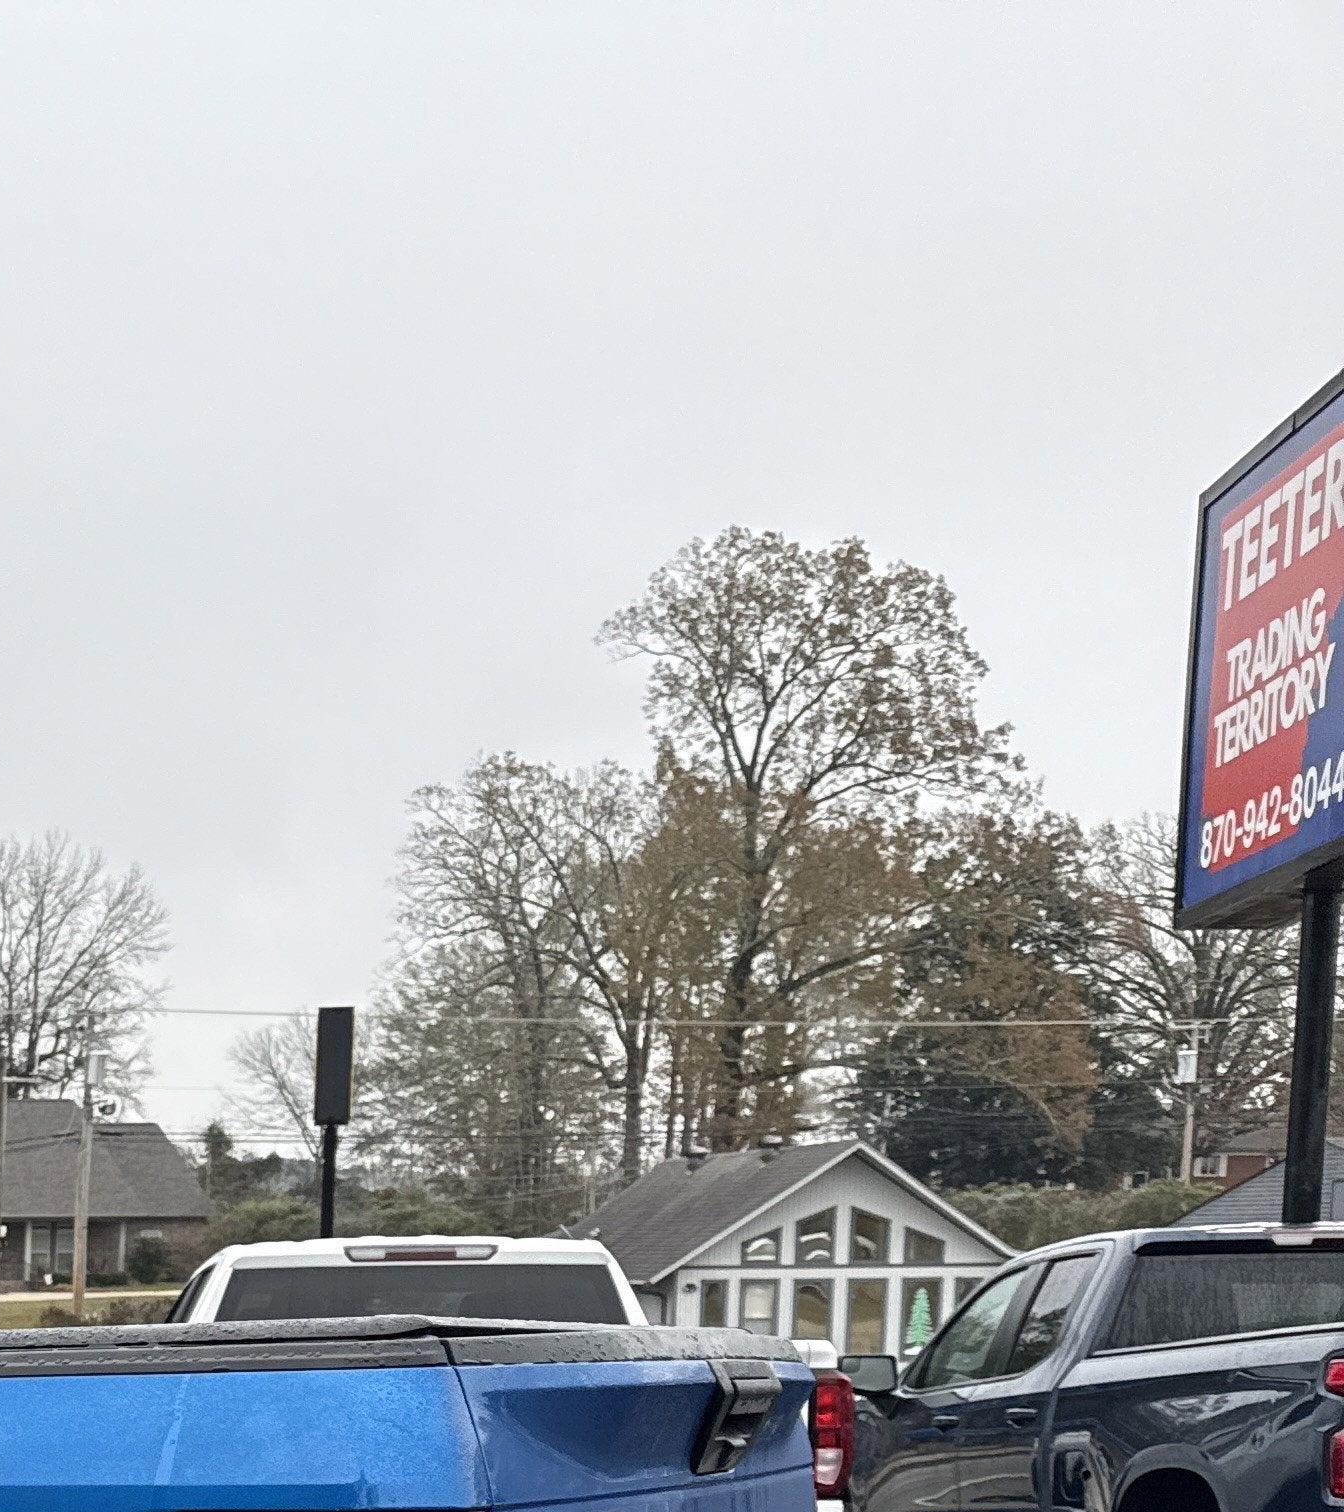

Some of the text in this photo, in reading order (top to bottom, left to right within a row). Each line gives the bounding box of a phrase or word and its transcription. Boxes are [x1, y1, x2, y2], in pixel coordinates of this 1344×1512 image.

[1223, 438, 1344, 611] TEETER
[1214, 642, 1336, 768] TERRITORY
[1227, 587, 1326, 702] TRADING
[1200, 750, 1344, 869] 870-942-8044
